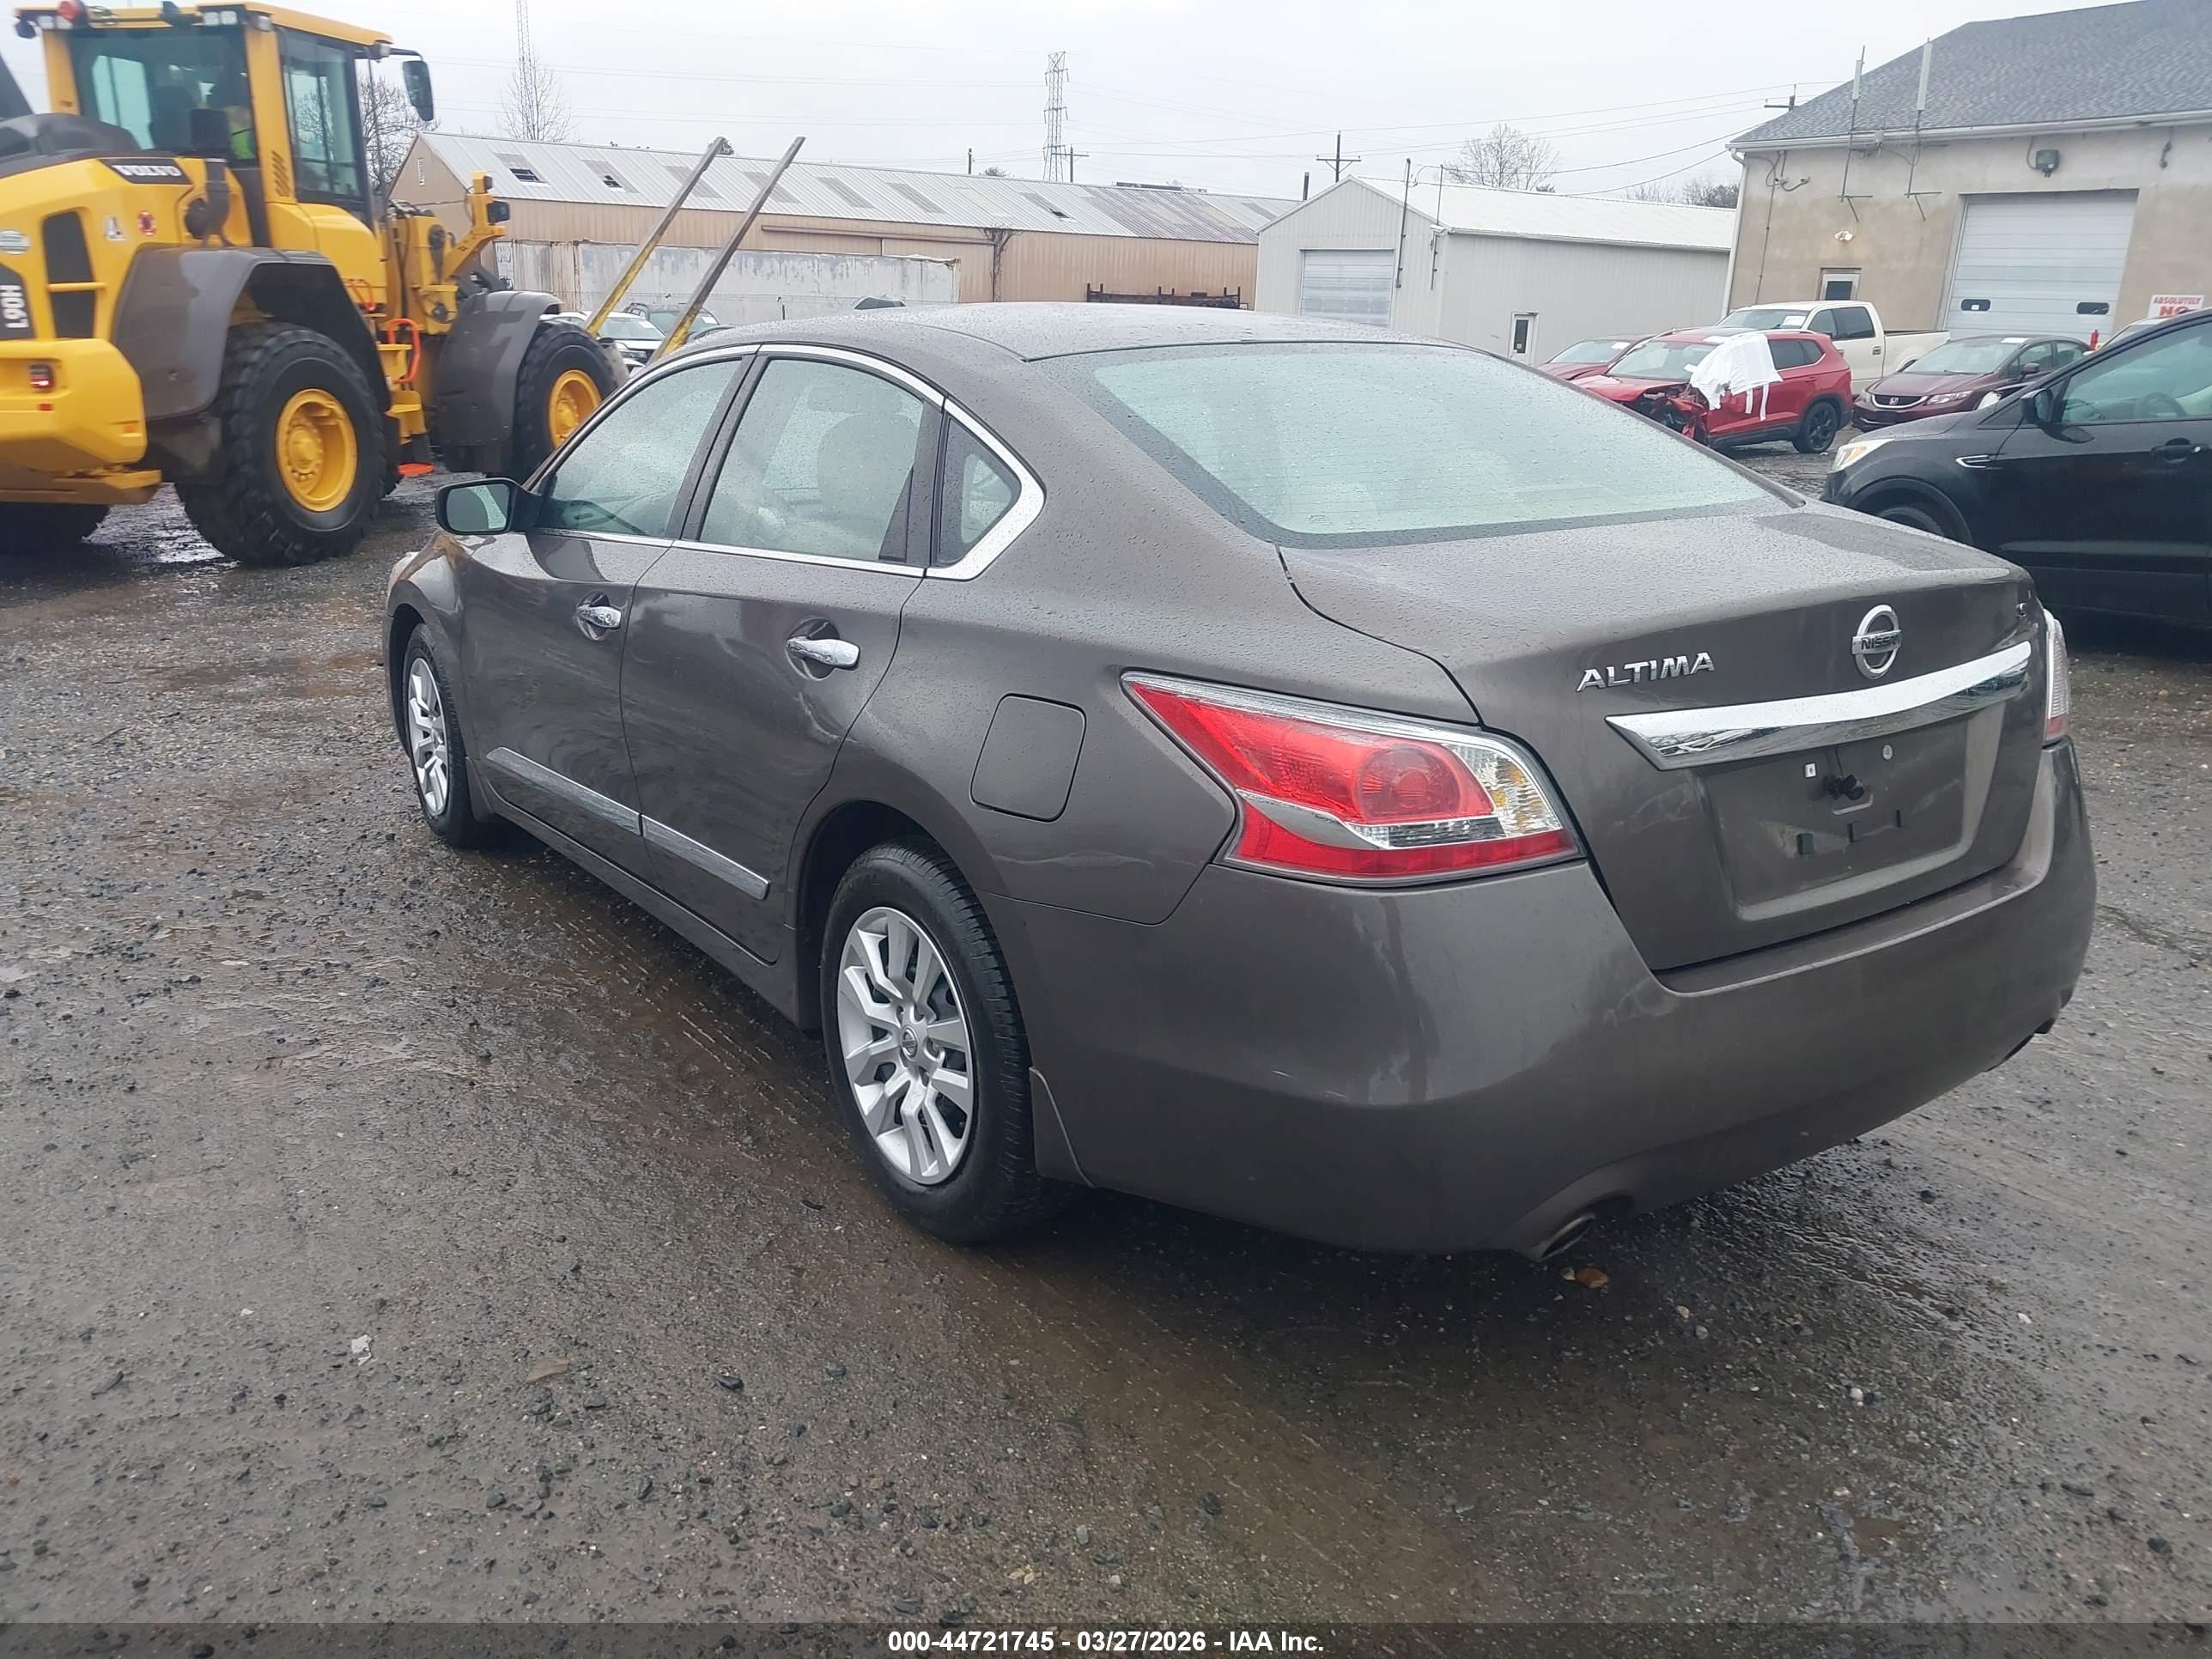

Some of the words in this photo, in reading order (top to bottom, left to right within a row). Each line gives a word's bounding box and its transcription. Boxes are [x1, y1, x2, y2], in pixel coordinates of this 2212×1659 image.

[112, 165, 182, 176] VOLVO
[0, 284, 29, 328] L90H
[1576, 652, 1715, 692] ALTIMA
